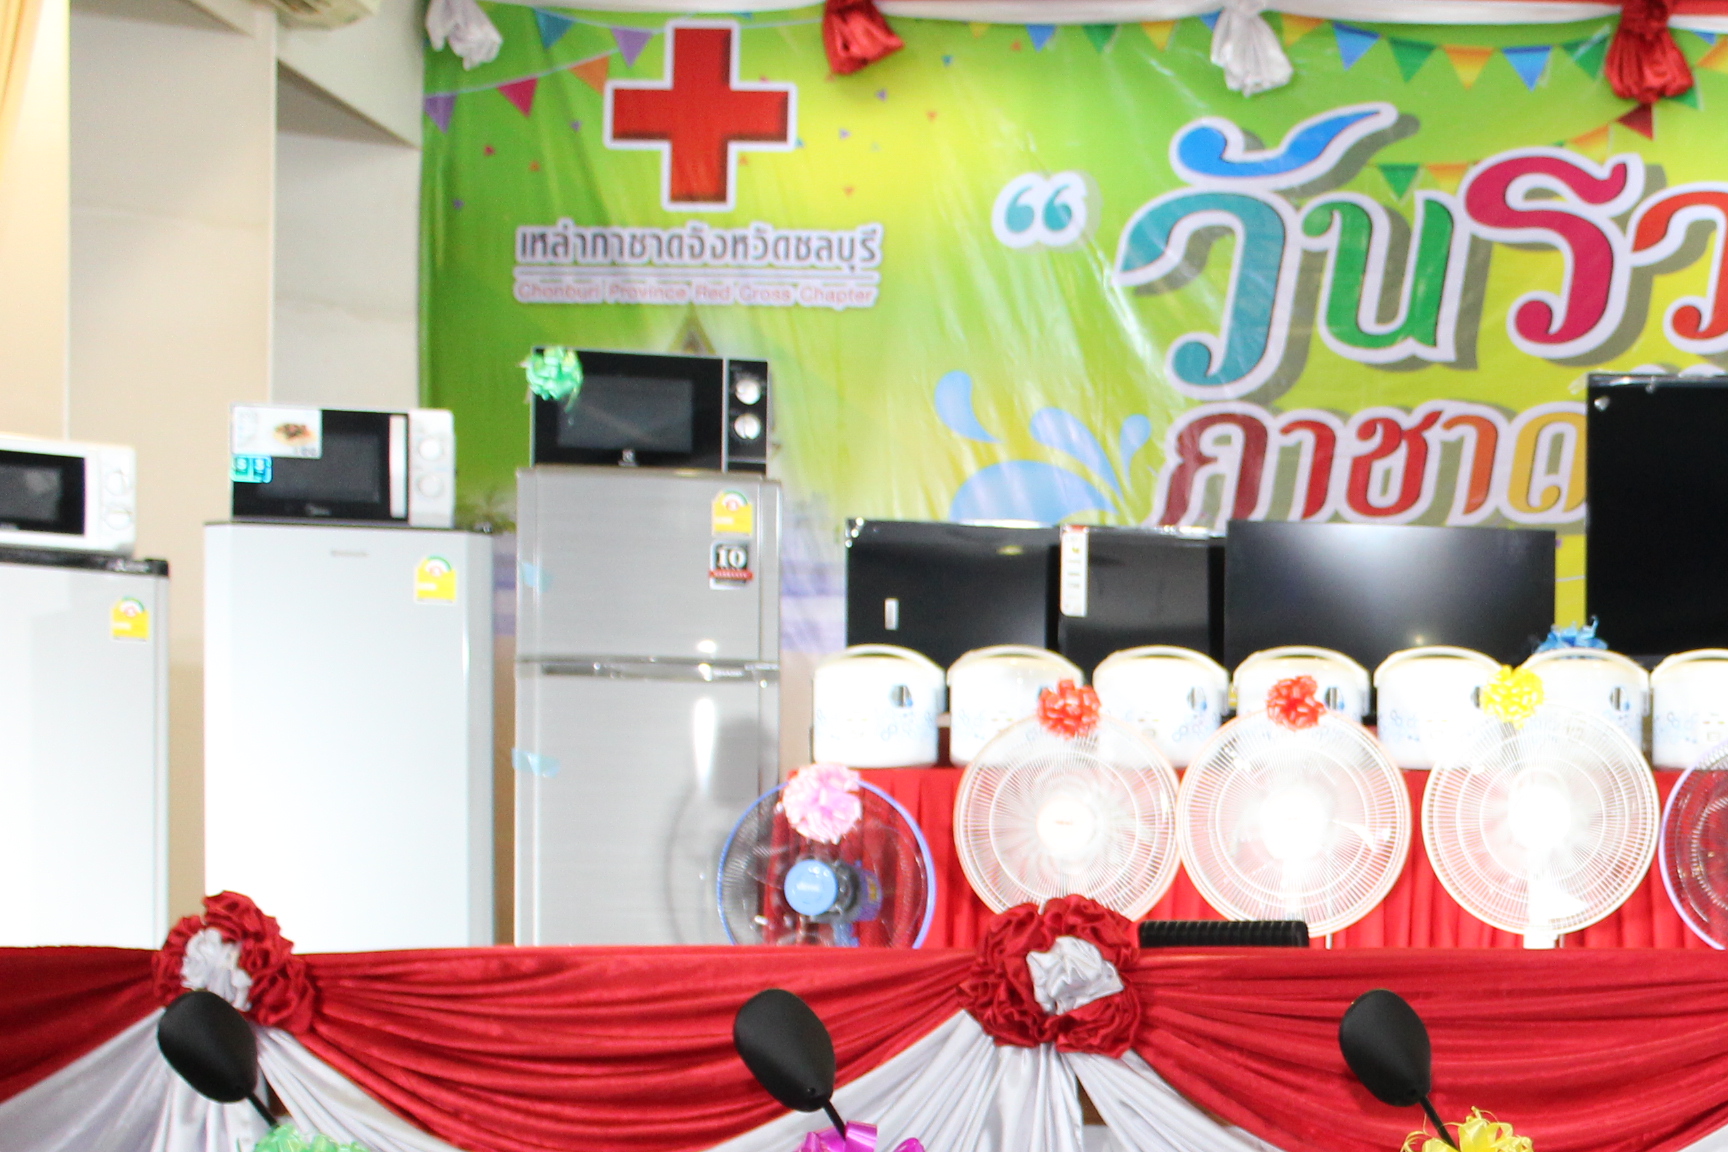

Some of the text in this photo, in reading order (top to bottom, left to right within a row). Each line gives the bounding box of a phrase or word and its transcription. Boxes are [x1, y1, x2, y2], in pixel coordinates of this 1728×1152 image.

[519, 221, 879, 273] เหล่ากาชาดจังหวัดชลบุรี
[518, 282, 876, 306] Chonburi Province Red Cross Chapter
[717, 546, 747, 568] 10
